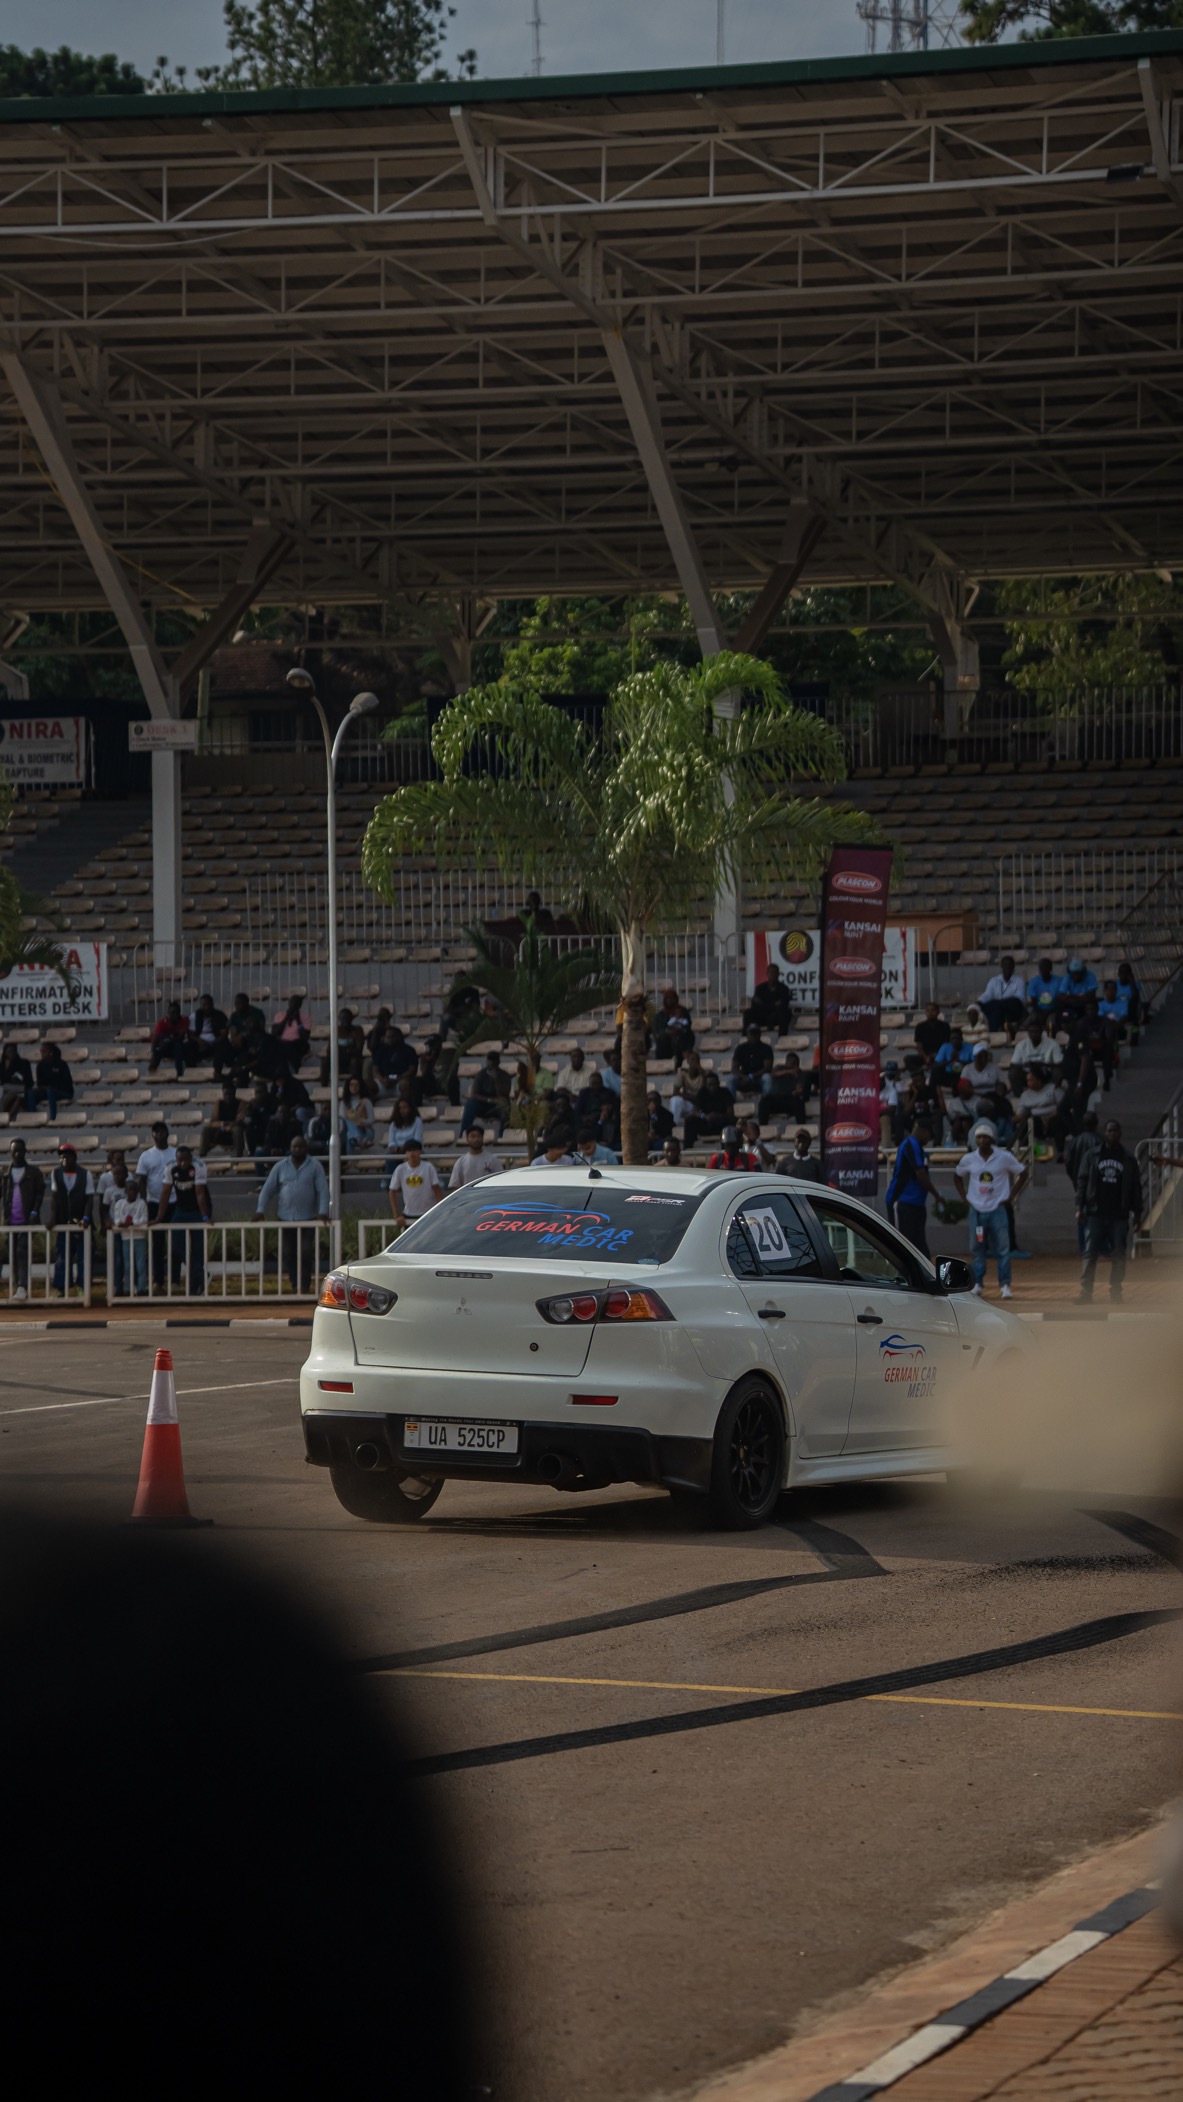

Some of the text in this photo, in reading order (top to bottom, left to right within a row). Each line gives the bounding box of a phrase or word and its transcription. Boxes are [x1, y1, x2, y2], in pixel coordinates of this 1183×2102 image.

[9, 721, 64, 739] NIRA
[18, 755, 25, 764] &
[27, 752, 75, 764] BIOMETRIC
[837, 877, 877, 888] PLASCON
[844, 920, 881, 933] KANSAI
[835, 963, 871, 971] PLASCON
[0, 984, 93, 999] NFIRMATON
[0, 1001, 92, 1016] TTERS DESK
[839, 1004, 877, 1016] KANSAI
[838, 1013, 860, 1022] PAINT
[837, 1087, 876, 1098] KANSAI
[837, 1097, 859, 1105] PAINT
[838, 1169, 874, 1179] KANSAI
[475, 1220, 635, 1241] GERMAN CAR
[748, 1216, 783, 1252] 20
[537, 1232, 628, 1251] MEDIC
[884, 1366, 937, 1383] GERMAN CAR
[907, 1382, 936, 1398] MEDIC
[428, 1425, 505, 1449] UA 525CP
